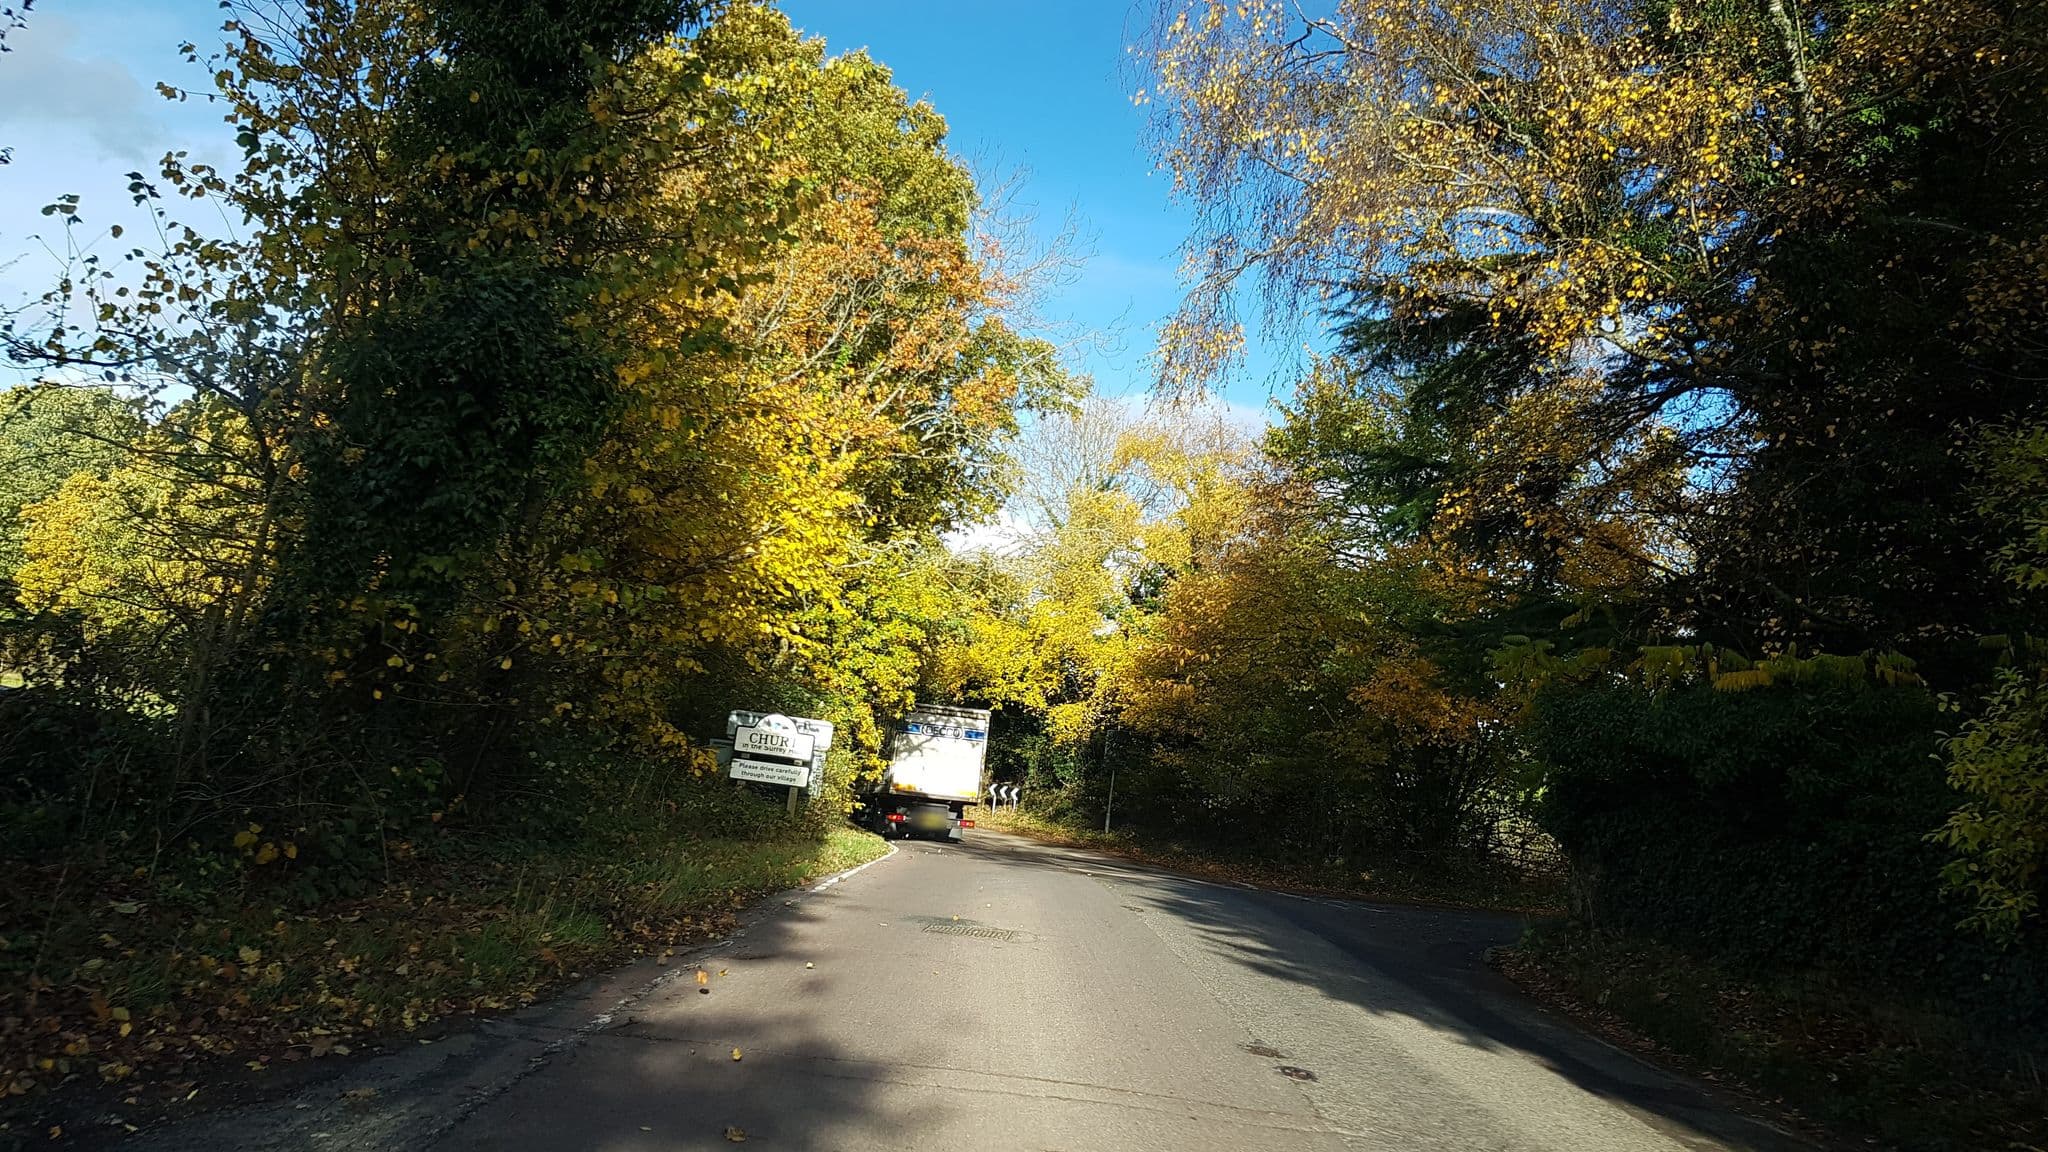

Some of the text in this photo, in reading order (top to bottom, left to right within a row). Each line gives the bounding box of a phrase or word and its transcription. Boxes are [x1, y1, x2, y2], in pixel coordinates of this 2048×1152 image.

[763, 745, 786, 754] Surrey
[739, 762, 758, 770] Please
[775, 768, 802, 776] carefully
[741, 770, 764, 778] through
[778, 775, 796, 783] village
